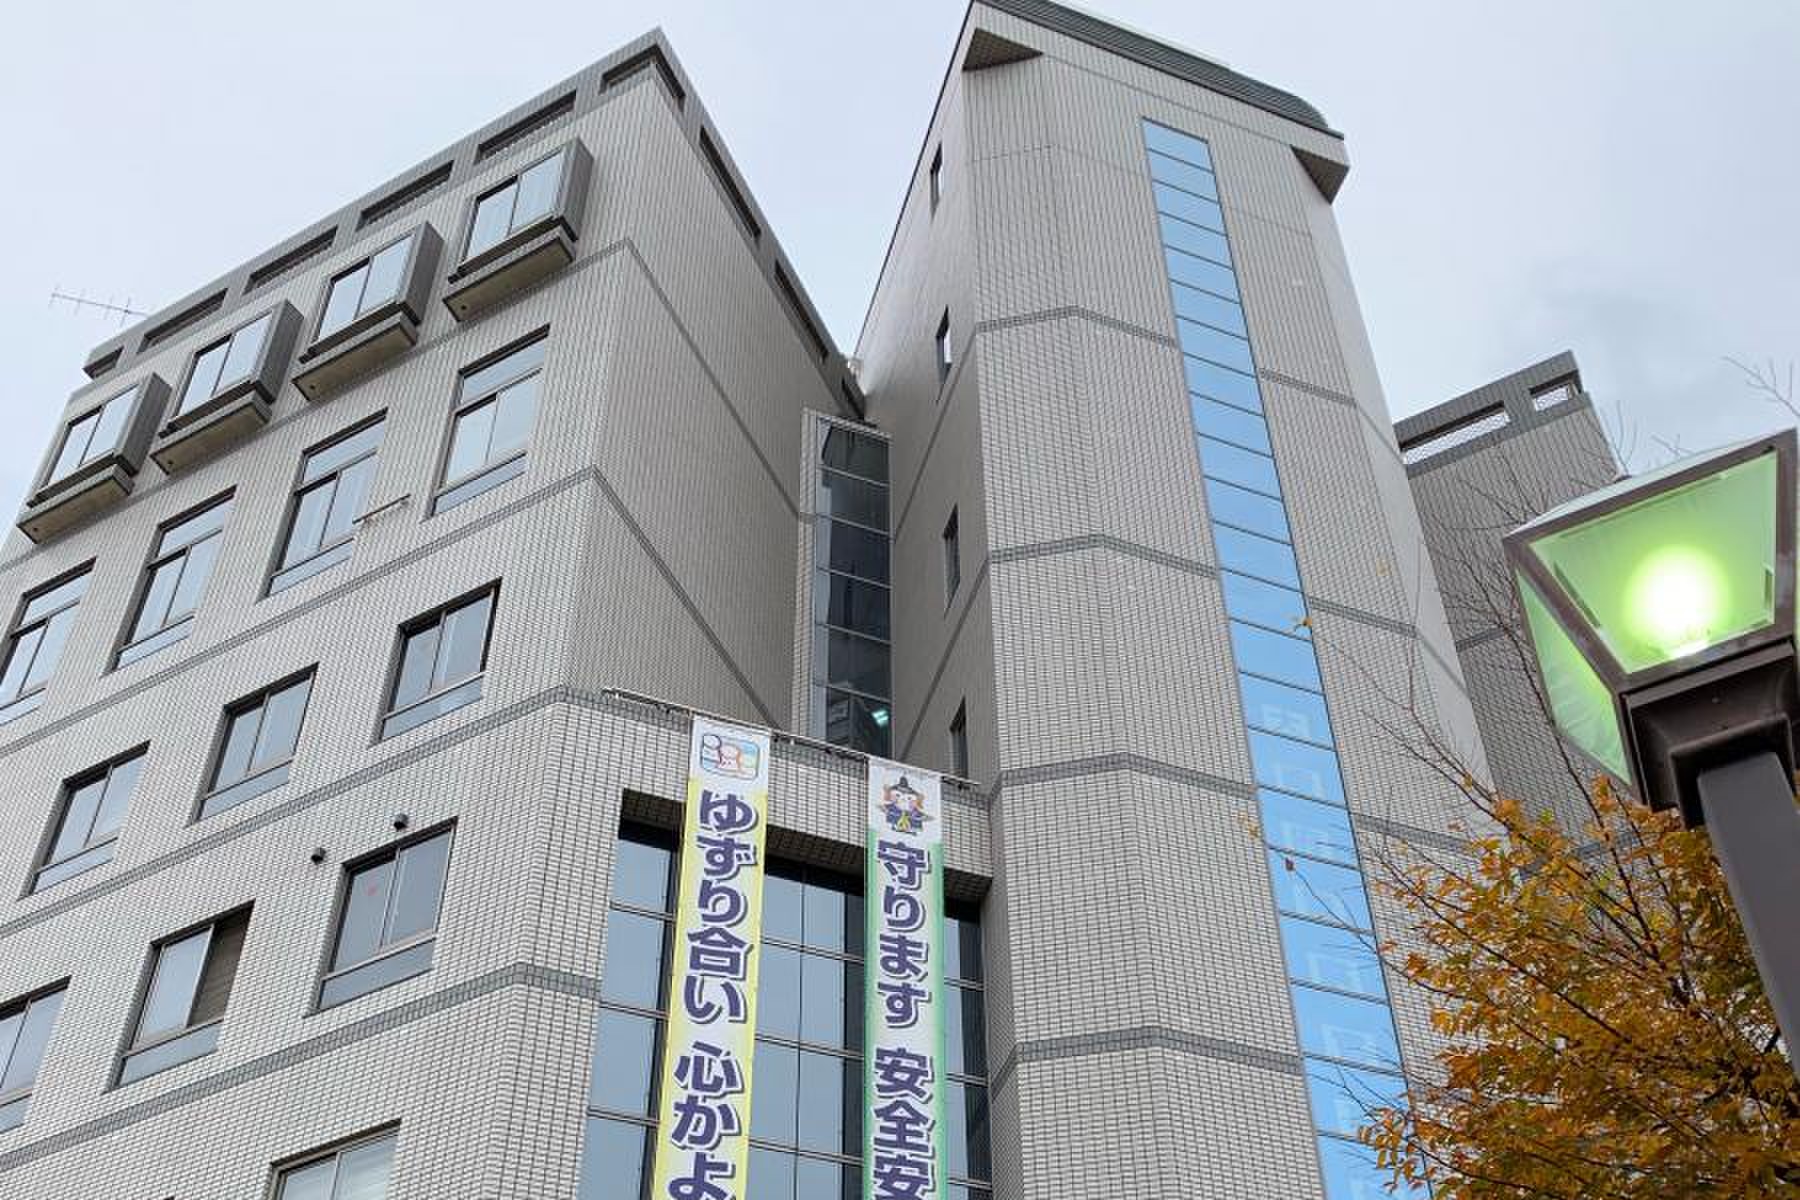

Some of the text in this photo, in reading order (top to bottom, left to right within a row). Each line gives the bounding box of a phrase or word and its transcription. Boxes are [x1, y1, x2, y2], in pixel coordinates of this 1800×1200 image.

[683, 789, 758, 1023] ゆずり合い
[876, 840, 931, 1029] 守ります
